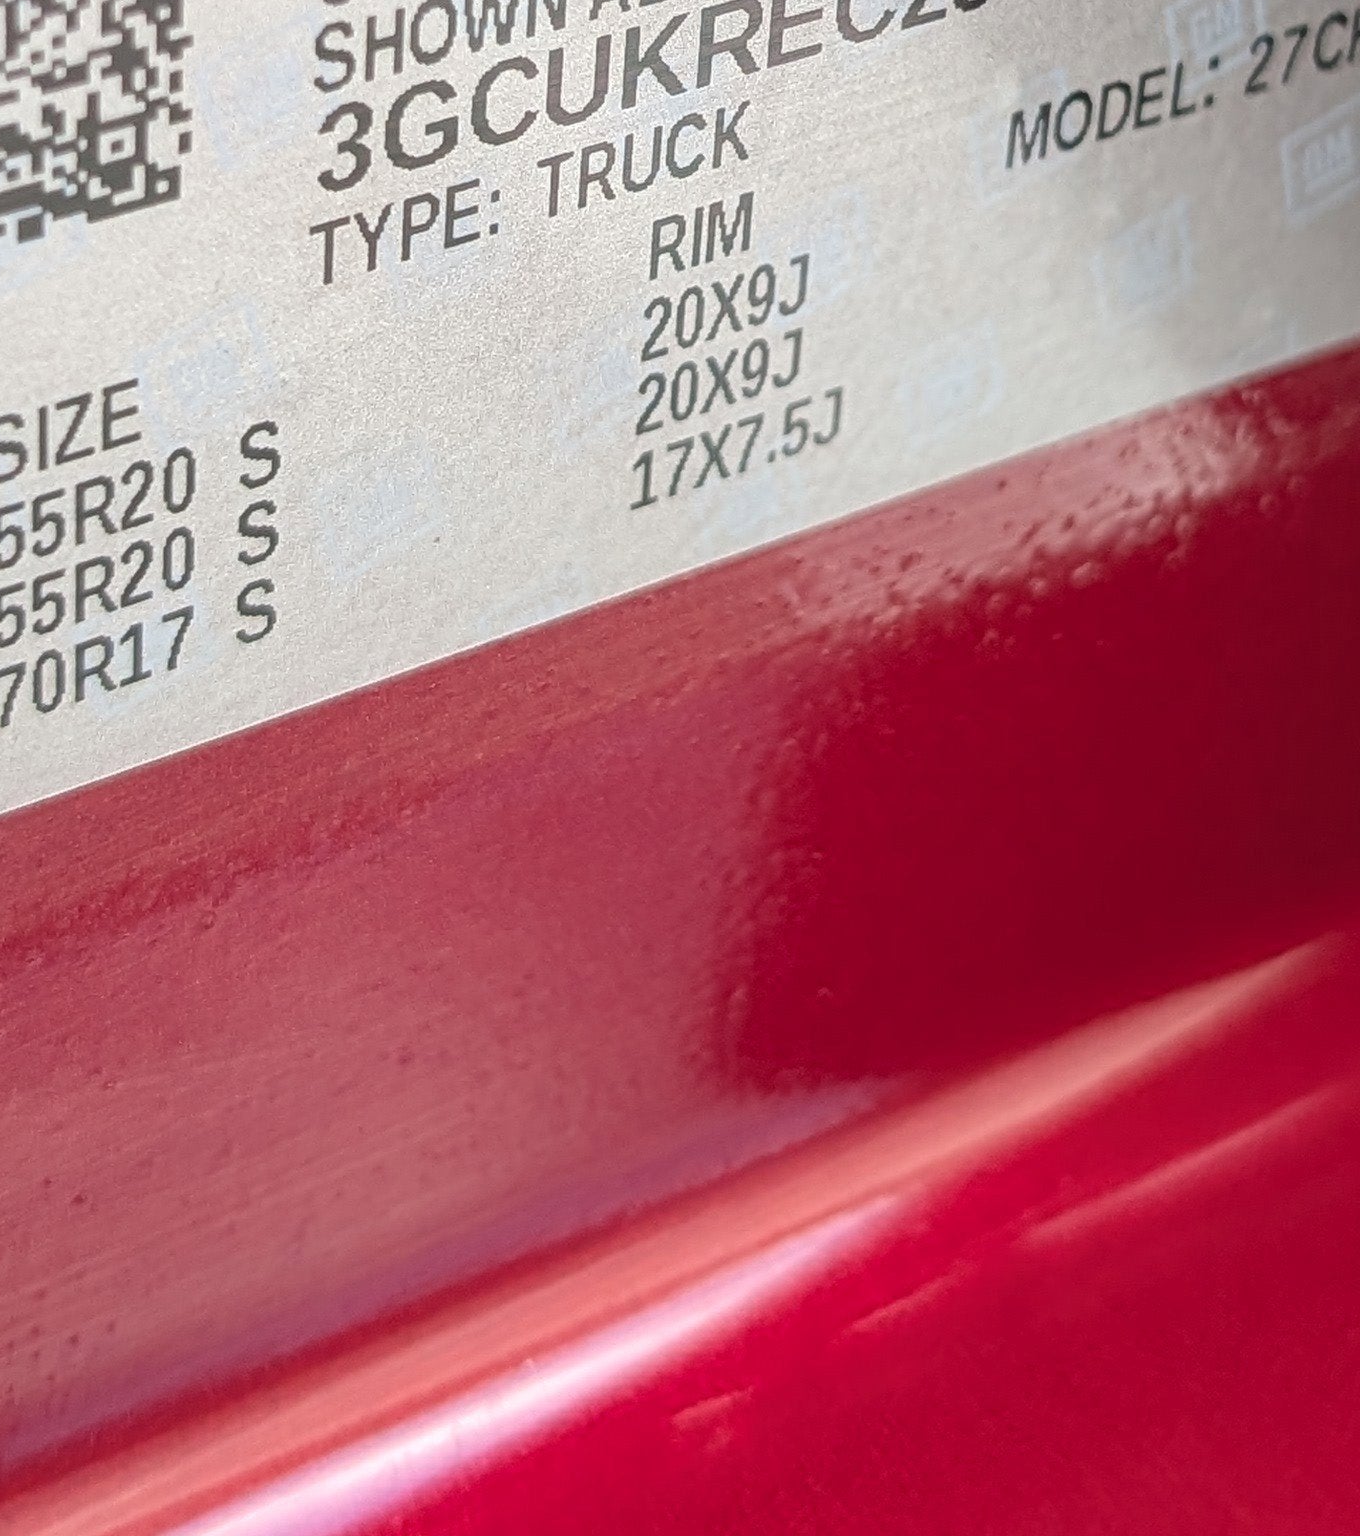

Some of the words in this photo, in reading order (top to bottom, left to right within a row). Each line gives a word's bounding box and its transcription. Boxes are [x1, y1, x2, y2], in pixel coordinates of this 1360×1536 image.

[1004, 59, 1219, 170] MODEL:
[309, 177, 503, 286] TYPE:
[537, 100, 753, 219] TRUCK
[649, 191, 756, 280] RIM
[641, 252, 810, 363] 20X9J
[635, 327, 805, 436] 20X9J
[238, 420, 282, 490] S
[630, 385, 845, 511] 17X7.5J
[236, 497, 280, 567] S
[235, 576, 278, 645] S
